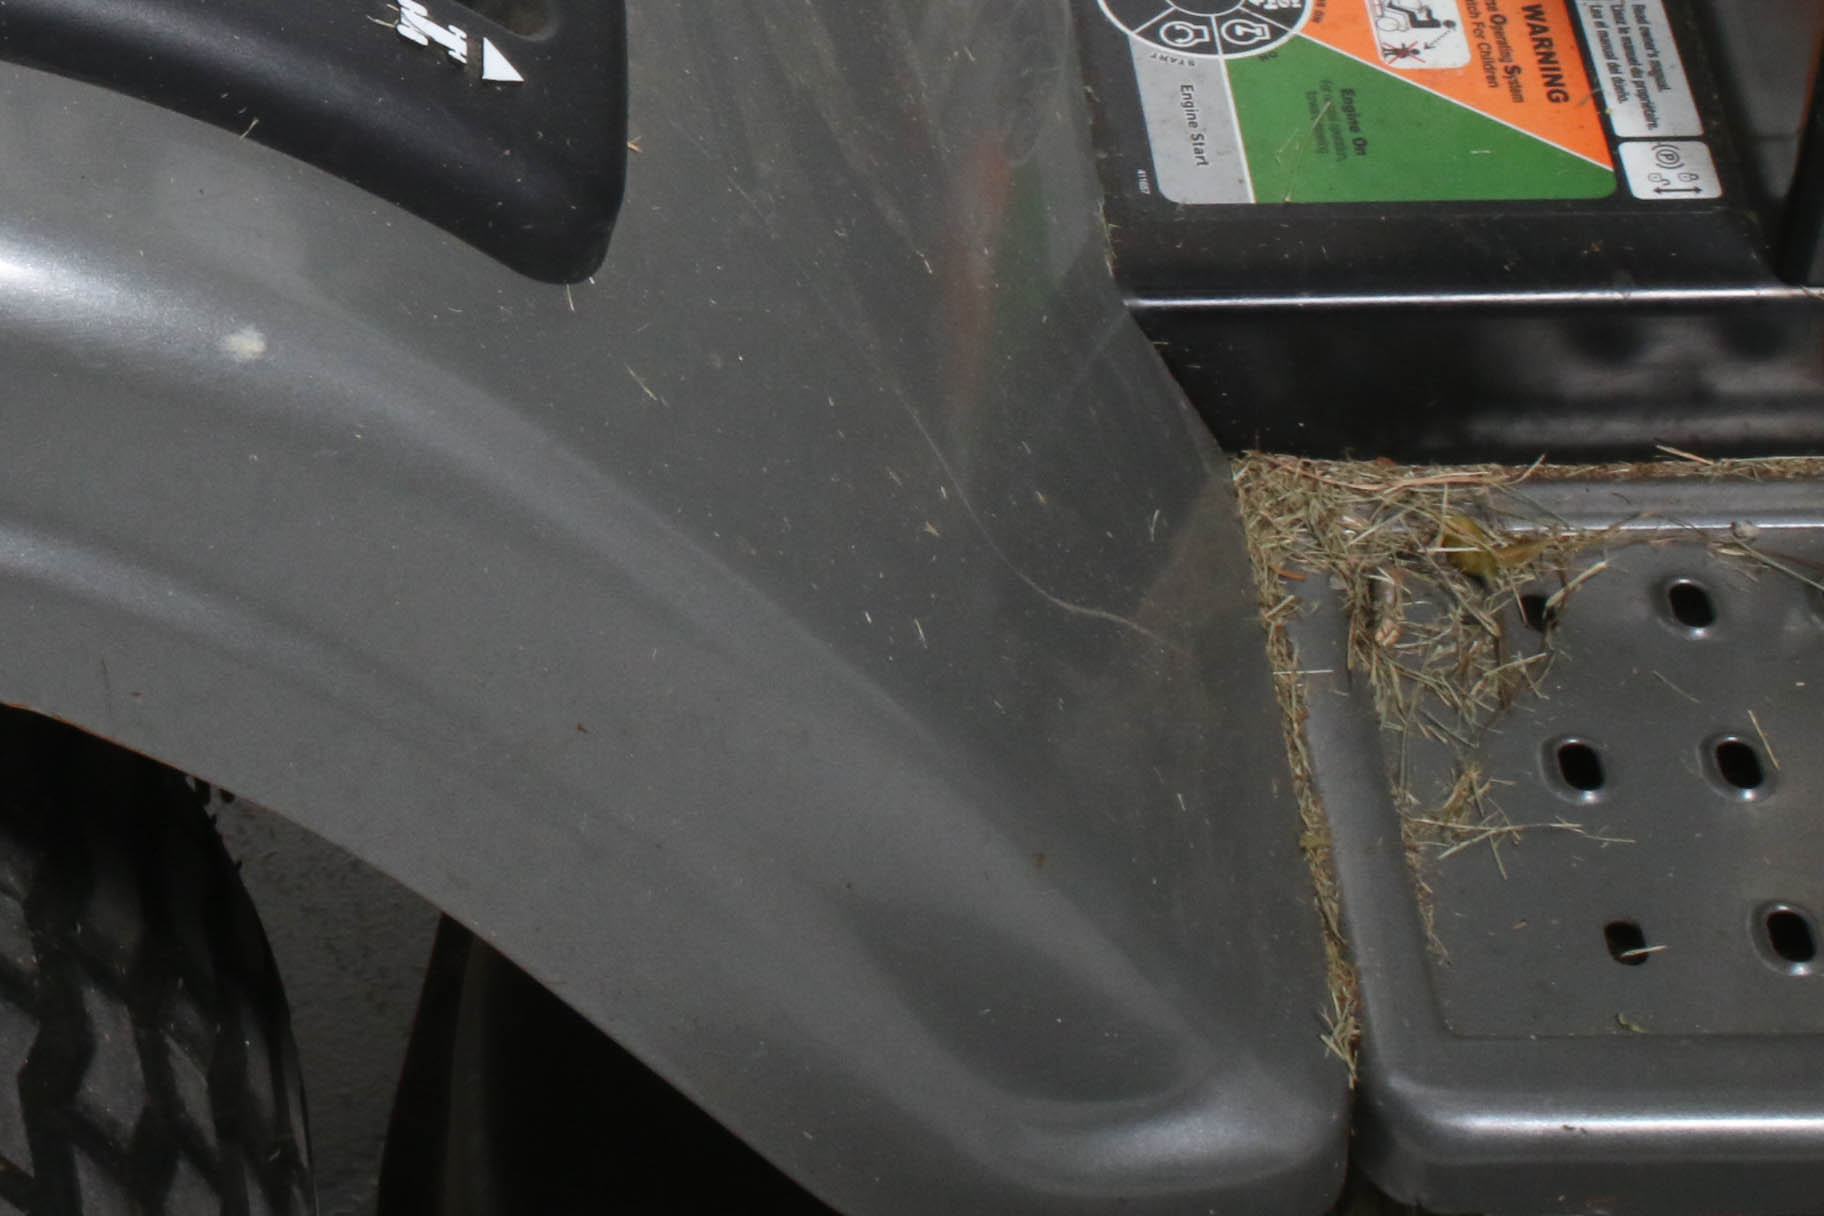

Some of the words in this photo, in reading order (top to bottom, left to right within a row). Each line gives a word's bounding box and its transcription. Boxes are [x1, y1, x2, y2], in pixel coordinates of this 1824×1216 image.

[1588, 4, 1603, 19] Lea
[1593, 20, 1608, 28] el
[1631, 3, 1650, 24] Read
[1471, 21, 1486, 39] For
[1596, 30, 1618, 60] manual
[1617, 26, 1630, 34] le
[1638, 26, 1659, 58] owner's
[1150, 51, 1196, 67] START
[1476, 42, 1499, 88] Children
[1488, 13, 1512, 62] Operating
[1502, 64, 1524, 103] System
[1520, 3, 1569, 103] WARNING
[1620, 35, 1642, 66] manuel
[1606, 62, 1622, 74] del
[1179, 84, 1198, 128] Engine
[1189, 132, 1209, 165] Start
[1339, 87, 1361, 133] Engine
[1351, 136, 1367, 155] On
